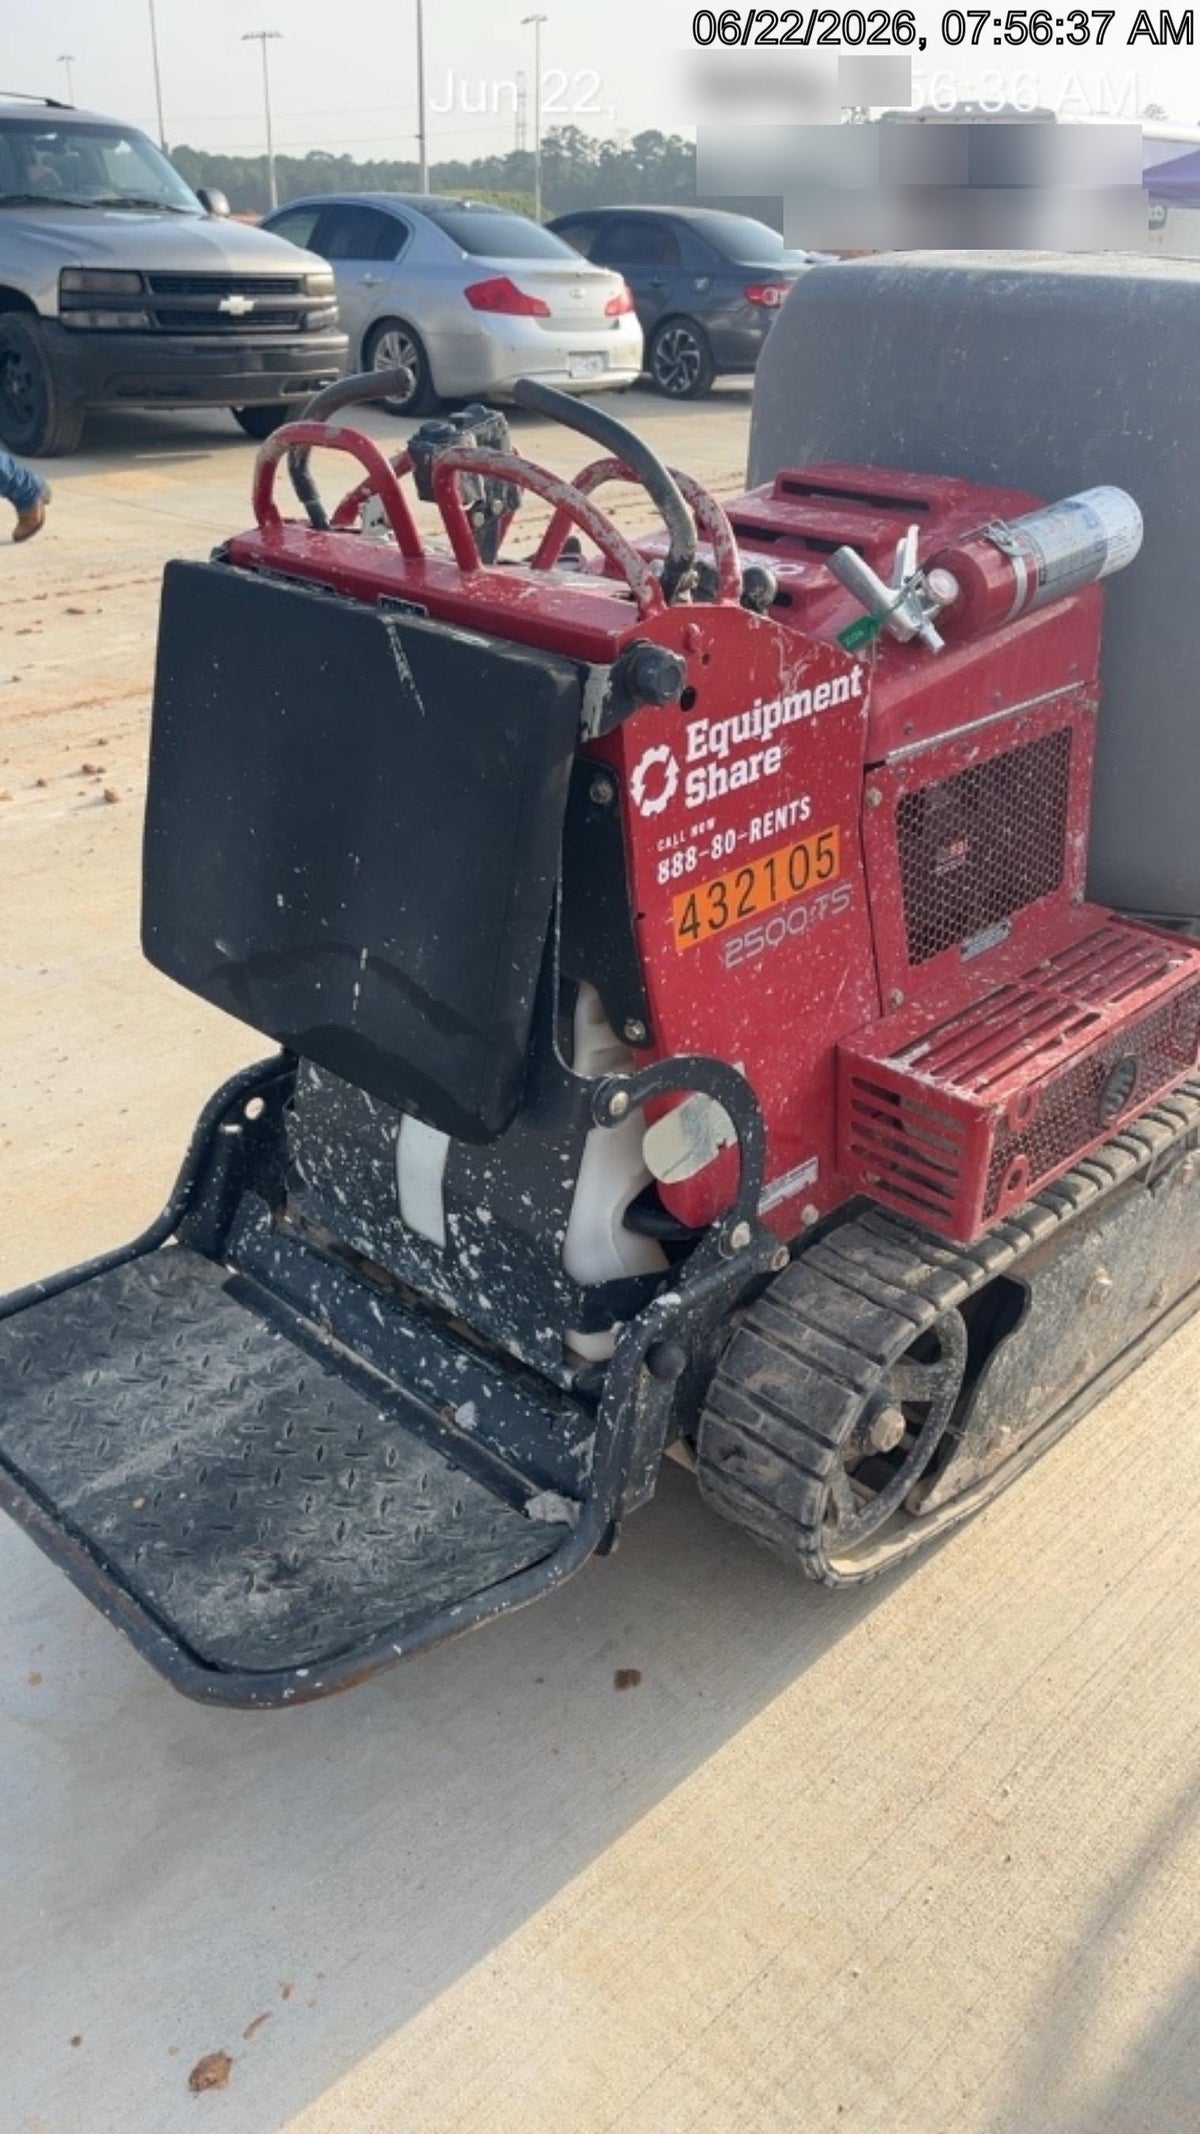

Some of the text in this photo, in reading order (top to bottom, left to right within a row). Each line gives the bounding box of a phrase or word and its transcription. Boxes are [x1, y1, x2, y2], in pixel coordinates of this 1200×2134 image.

[685, 664, 864, 762] Equipment
[685, 745, 782, 809] Share
[656, 796, 811, 884] 888-80-RENTS
[656, 831, 686, 852] CALL
[678, 832, 834, 940] 432105
